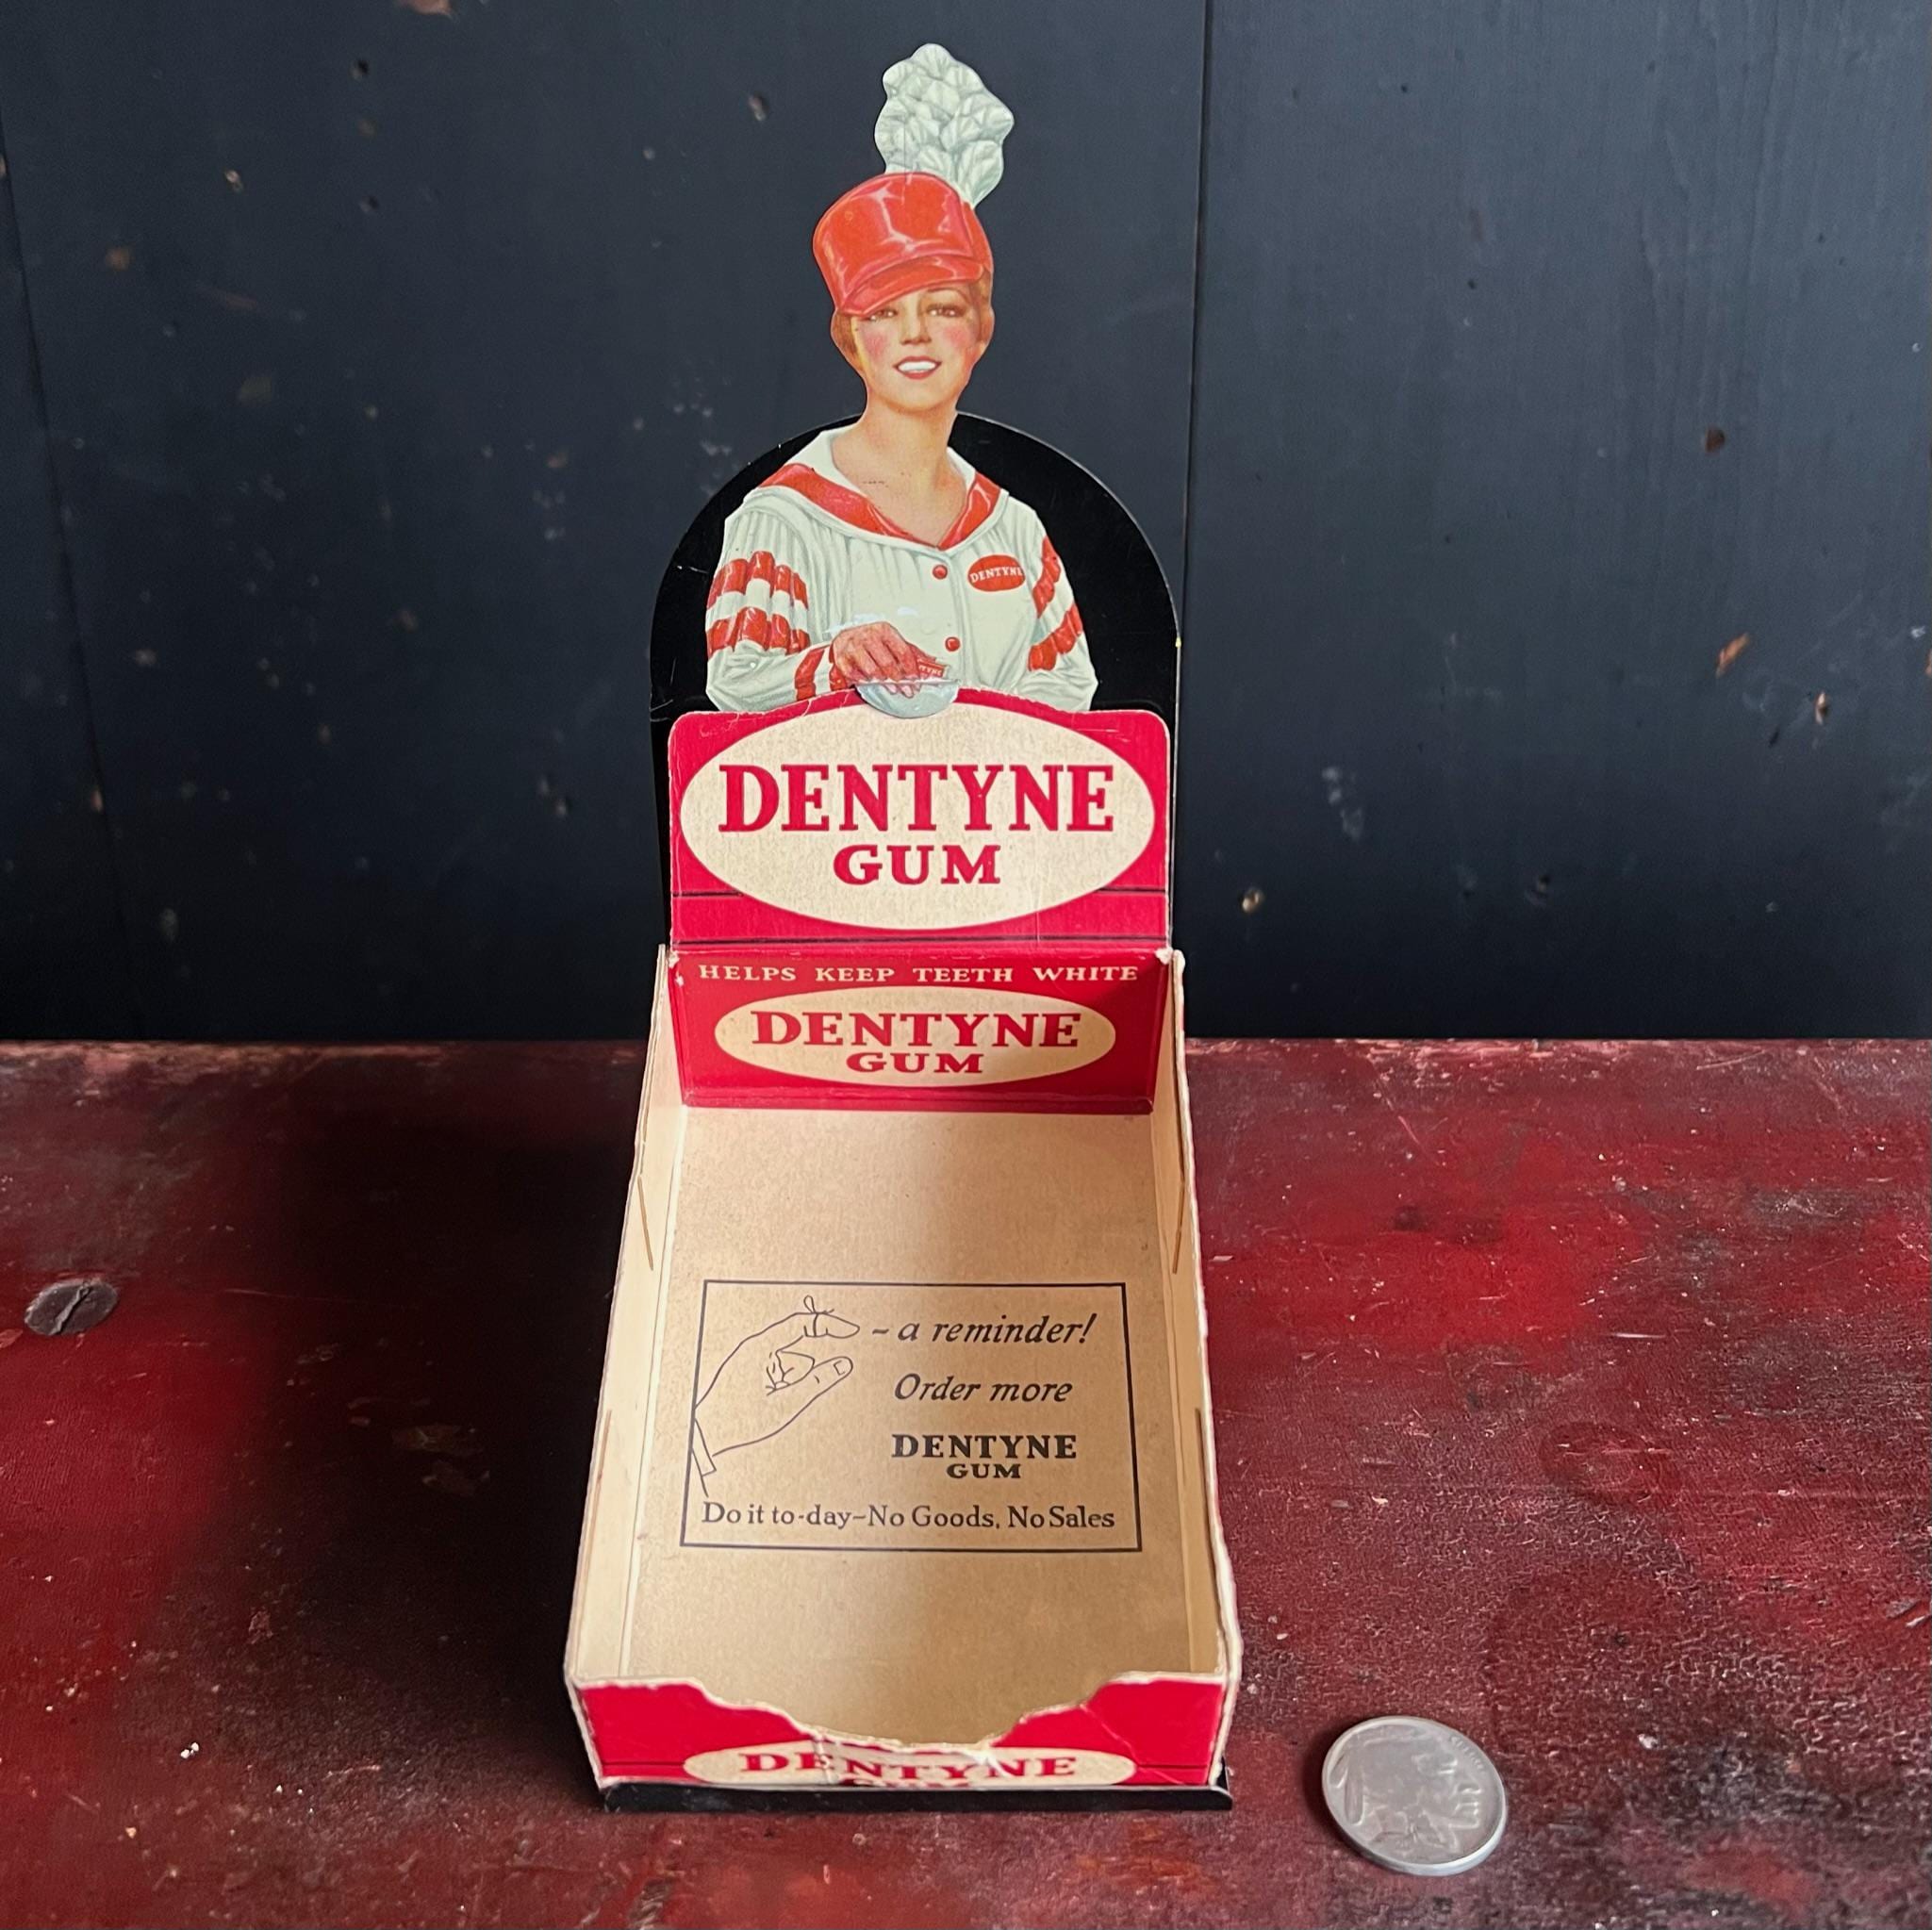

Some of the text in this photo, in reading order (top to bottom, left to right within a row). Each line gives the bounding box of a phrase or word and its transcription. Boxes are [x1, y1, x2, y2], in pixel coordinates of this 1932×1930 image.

[718, 764, 1115, 833] DENTYNE
[833, 844, 1000, 885] GUM
[699, 965, 1138, 982] HELPS KEEP TEETH WHITE
[751, 1011, 1082, 1047] DENTYNE
[846, 1052, 984, 1074] GUM
[932, 1313, 1098, 1344] reminder!
[895, 1373, 1073, 1402] Order more
[891, 1434, 1077, 1459] DENTYNE
[947, 1463, 1021, 1479] GUM
[702, 1501, 742, 1524] Do
[748, 1504, 765, 1524] it
[912, 1505, 1000, 1529] Goods,
[1007, 1506, 1045, 1528] No
[1049, 1506, 1115, 1528] Sales
[739, 1753, 1076, 1779] DENTYNE
